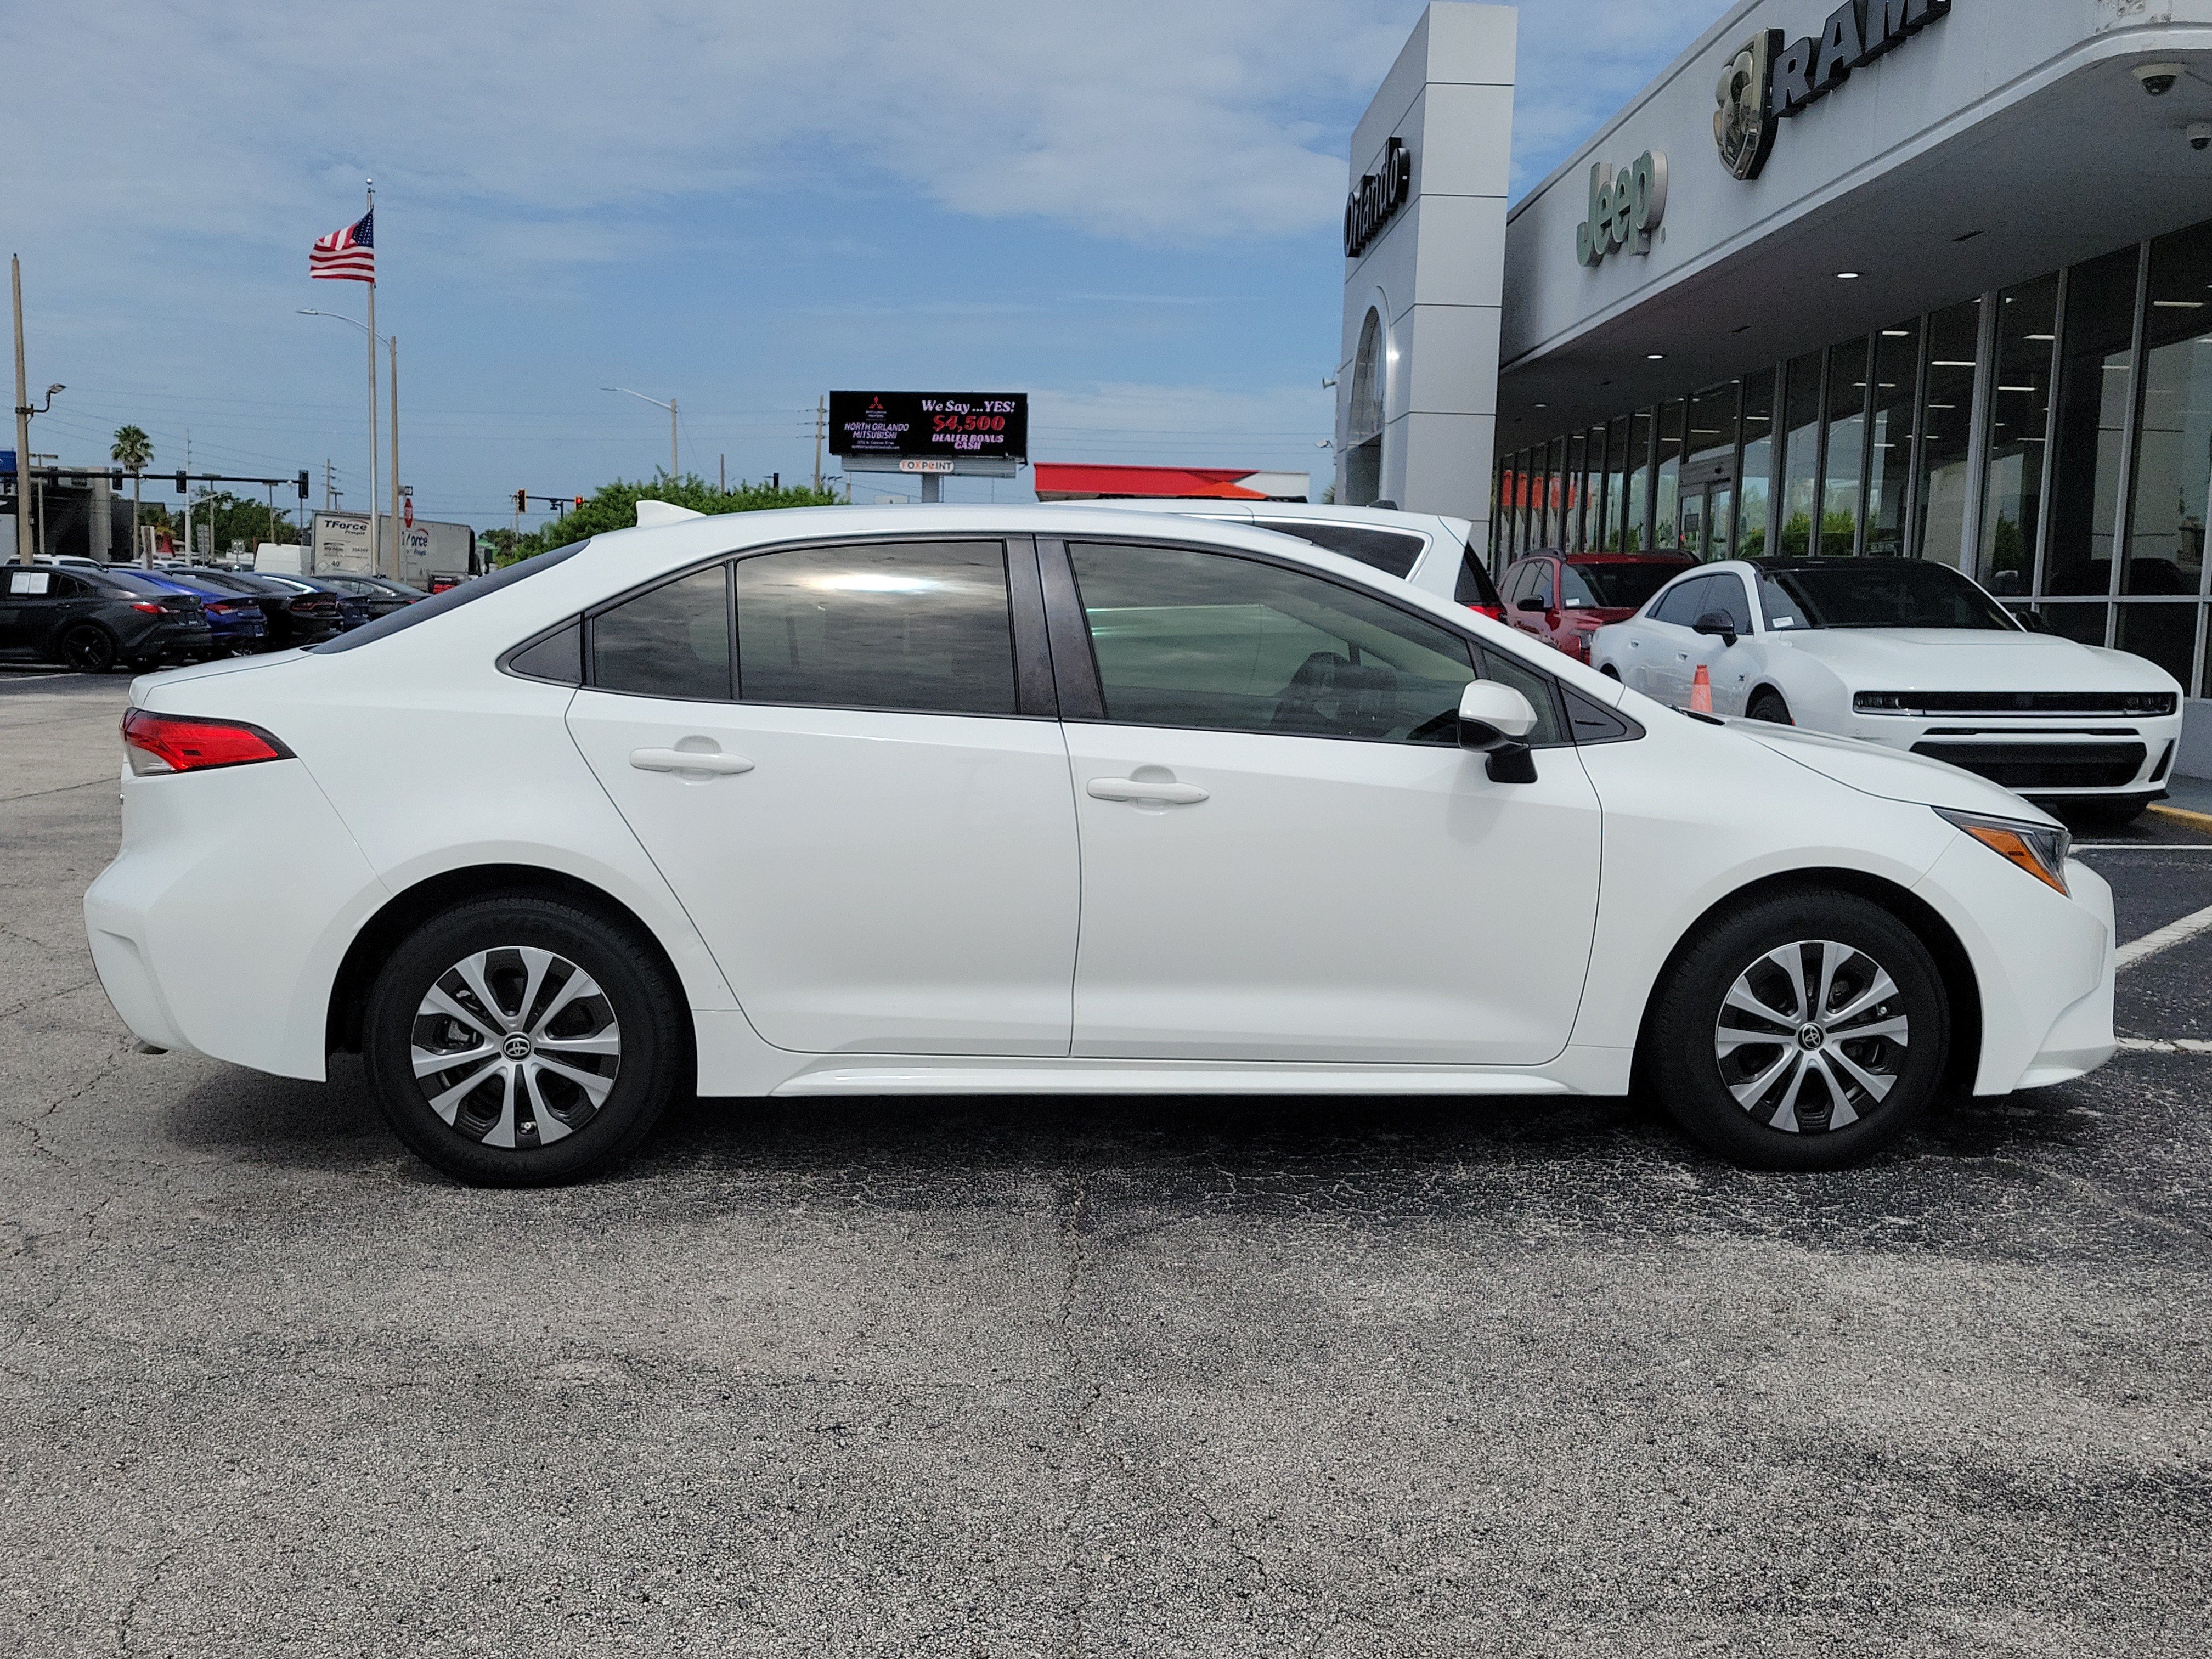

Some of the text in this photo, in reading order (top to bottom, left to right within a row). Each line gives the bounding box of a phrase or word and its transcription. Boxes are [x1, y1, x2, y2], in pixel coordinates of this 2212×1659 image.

[1771, 0, 1951, 119] RAM
[1344, 136, 1410, 258] Orlando
[1576, 150, 1668, 267] Jeep
[921, 400, 943, 411] We
[945, 400, 970, 415] Say
[844, 422, 910, 432] NORTH ORLANDO
[932, 414, 1006, 432] $4,500
[852, 431, 898, 439] MITSUBISHI
[932, 433, 1005, 443] DEALER BONUS
[954, 441, 982, 450] CASH
[901, 461, 952, 470] FOXPOINT
[324, 519, 368, 531] TForce
